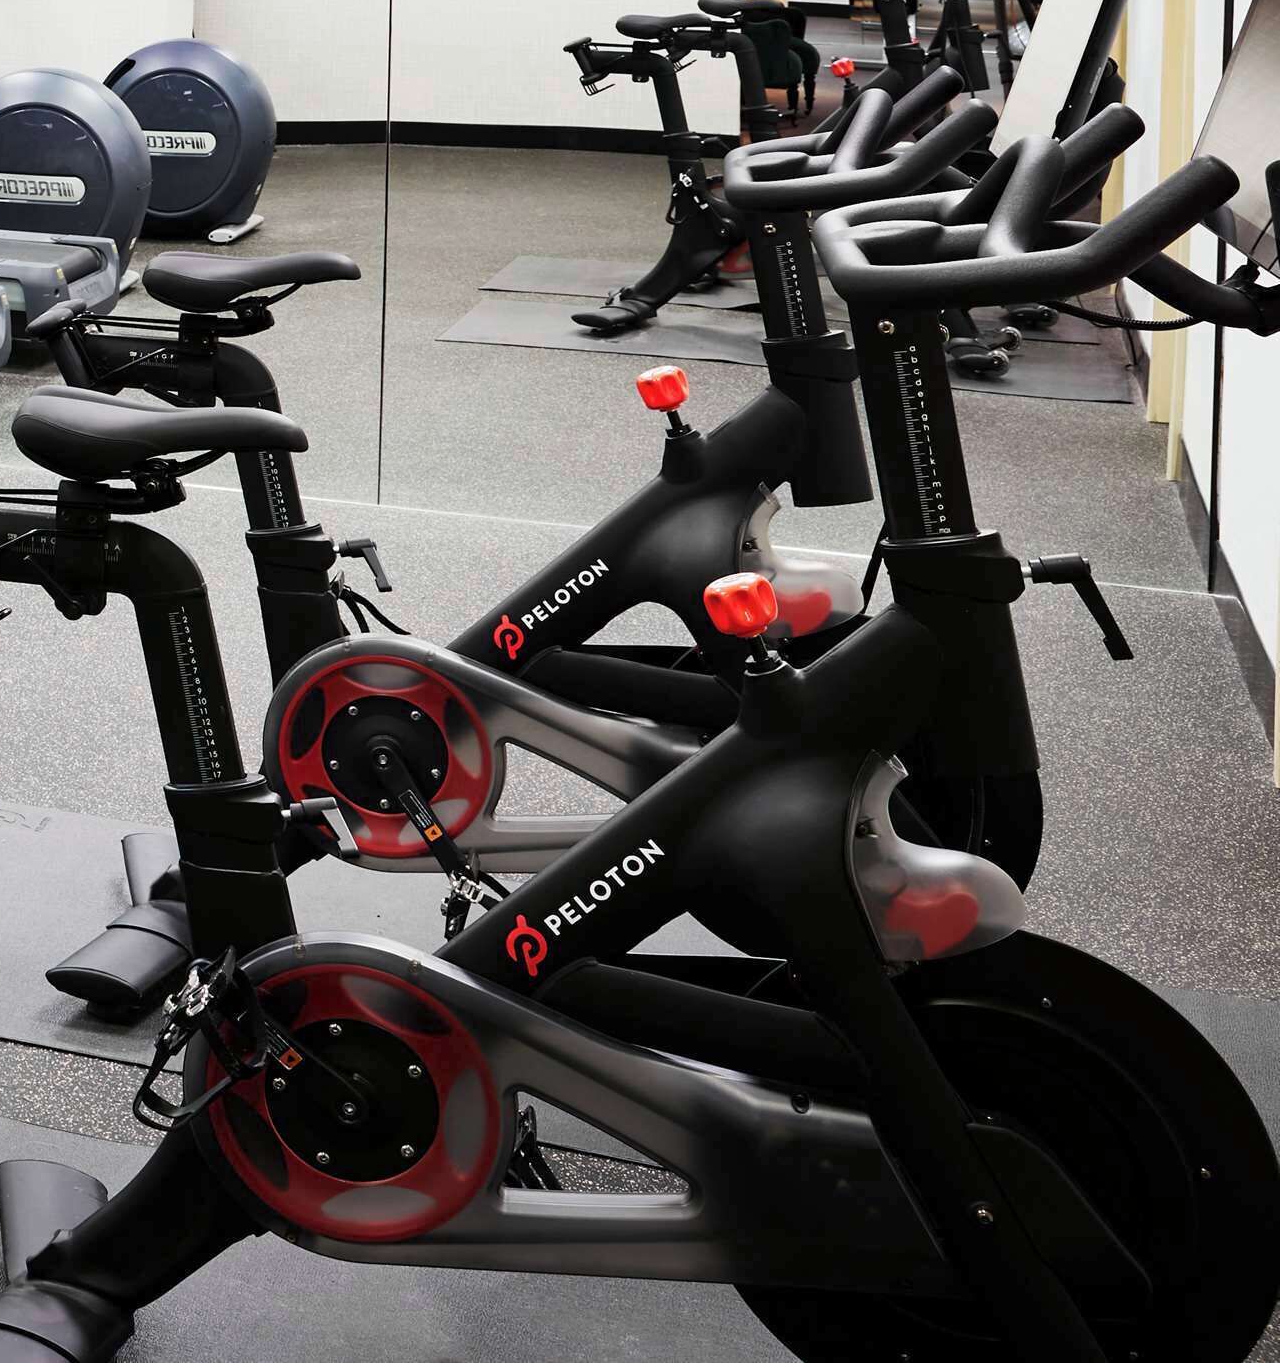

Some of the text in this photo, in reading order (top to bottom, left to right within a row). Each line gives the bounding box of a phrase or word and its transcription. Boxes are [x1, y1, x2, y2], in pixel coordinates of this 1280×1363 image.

[520, 558, 610, 630] PELOTON
[182, 615, 189, 624] 2
[184, 626, 191, 635] 3
[187, 636, 193, 644] 4
[188, 646, 195, 654] 5
[190, 657, 197, 665] 6
[192, 666, 199, 675] 7
[194, 677, 201, 685] 8
[196, 686, 203, 695] 9
[197, 697, 208, 706] 10
[199, 707, 209, 716] 11
[201, 718, 212, 727] 12
[203, 728, 214, 737] 13
[205, 738, 216, 747] 14
[208, 750, 219, 759] 15
[210, 761, 221, 770] 16
[212, 770, 222, 779] 17
[543, 838, 666, 936] PELOTON
